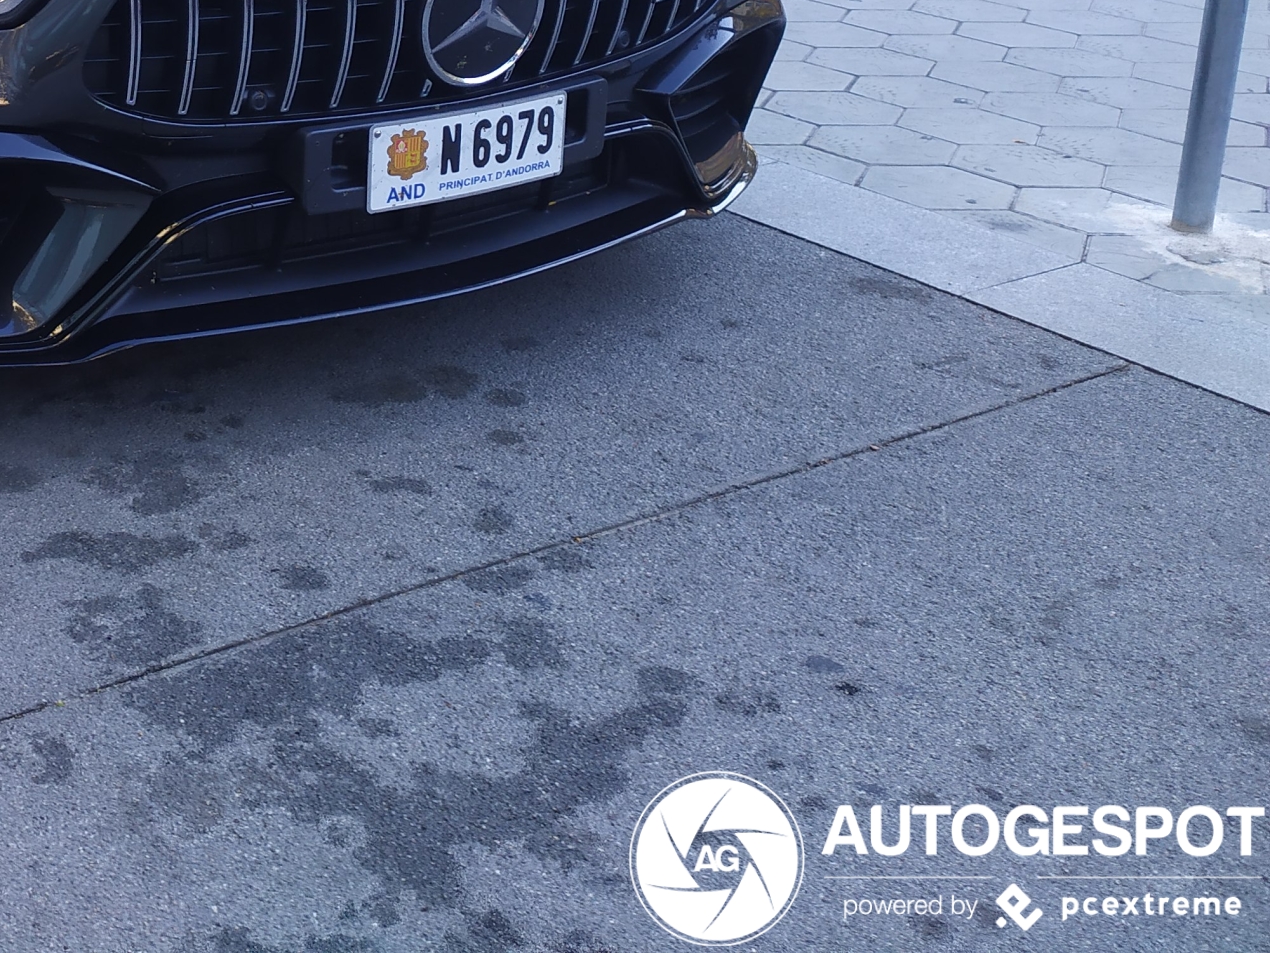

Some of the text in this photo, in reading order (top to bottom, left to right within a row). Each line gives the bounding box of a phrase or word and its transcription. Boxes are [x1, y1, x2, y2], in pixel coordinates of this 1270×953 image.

[440, 105, 555, 175] N 6979
[438, 159, 550, 192] PRINCIPAT D'ANDORRA
[386, 183, 426, 203] AND
